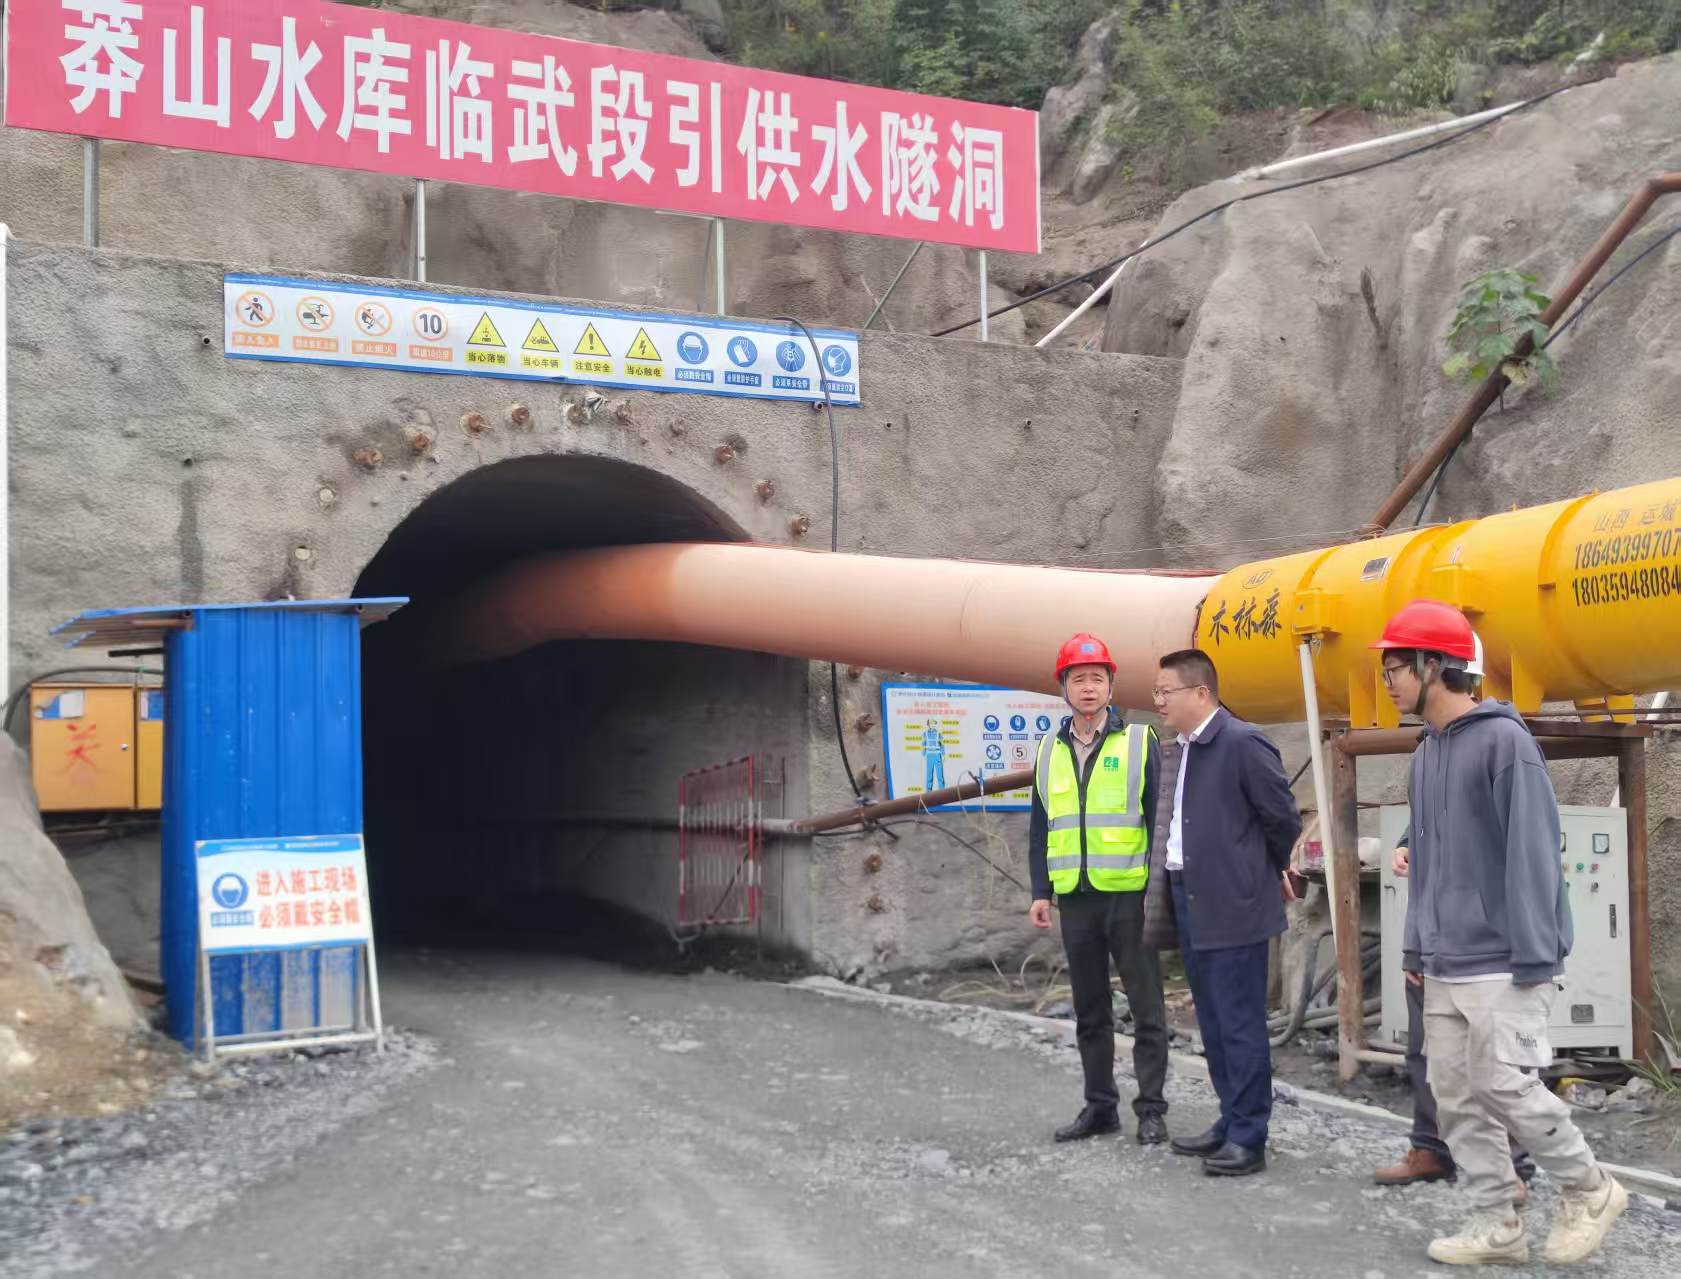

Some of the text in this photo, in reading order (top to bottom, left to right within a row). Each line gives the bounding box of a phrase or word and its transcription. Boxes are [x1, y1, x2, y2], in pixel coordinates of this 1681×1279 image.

[59, 0, 1004, 230] 莽山水库临武段引供水隧洞
[419, 313, 442, 335] 10
[468, 351, 506, 364] 当心落物
[523, 356, 559, 369] 当心车辆
[575, 360, 611, 374] 注意安全
[626, 365, 661, 377] 当心触电
[1575, 528, 1681, 570] 18649399707
[1572, 565, 1681, 607] 18035948084
[1208, 588, 1282, 648] 木林森
[1016, 747, 1024, 758] 5
[256, 866, 357, 896] 进入施工现场
[259, 897, 360, 929] 必须戴安全帽
